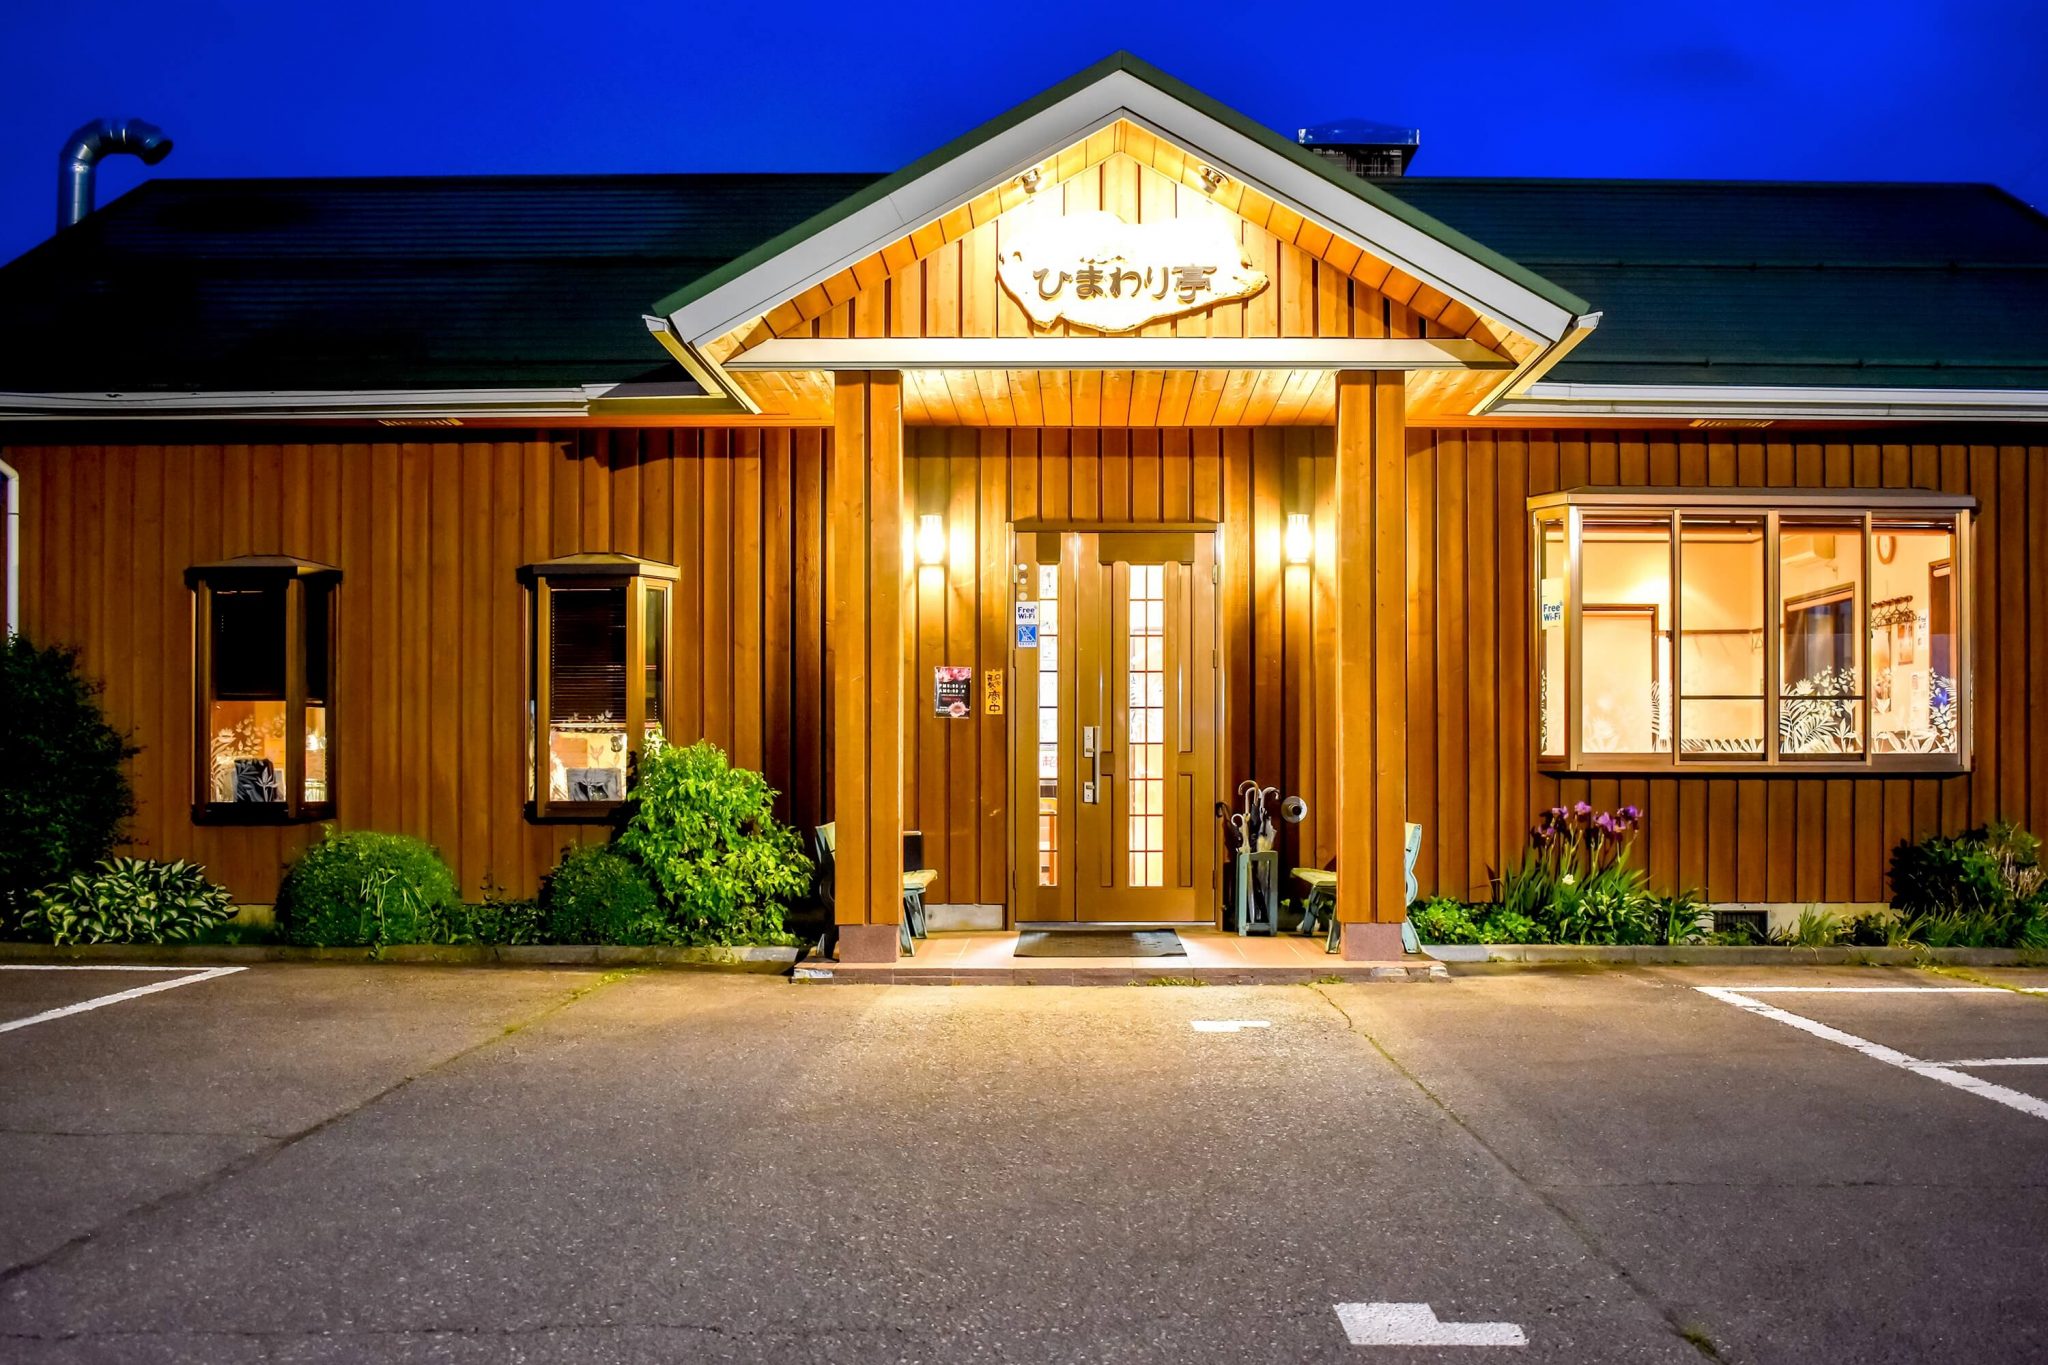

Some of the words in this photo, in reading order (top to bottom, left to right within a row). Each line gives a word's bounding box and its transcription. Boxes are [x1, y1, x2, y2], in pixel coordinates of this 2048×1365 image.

[1032, 263, 1217, 304] ひまわり亭
[1543, 603, 1561, 612] Free
[1543, 612, 1561, 621] Wi-Fi
